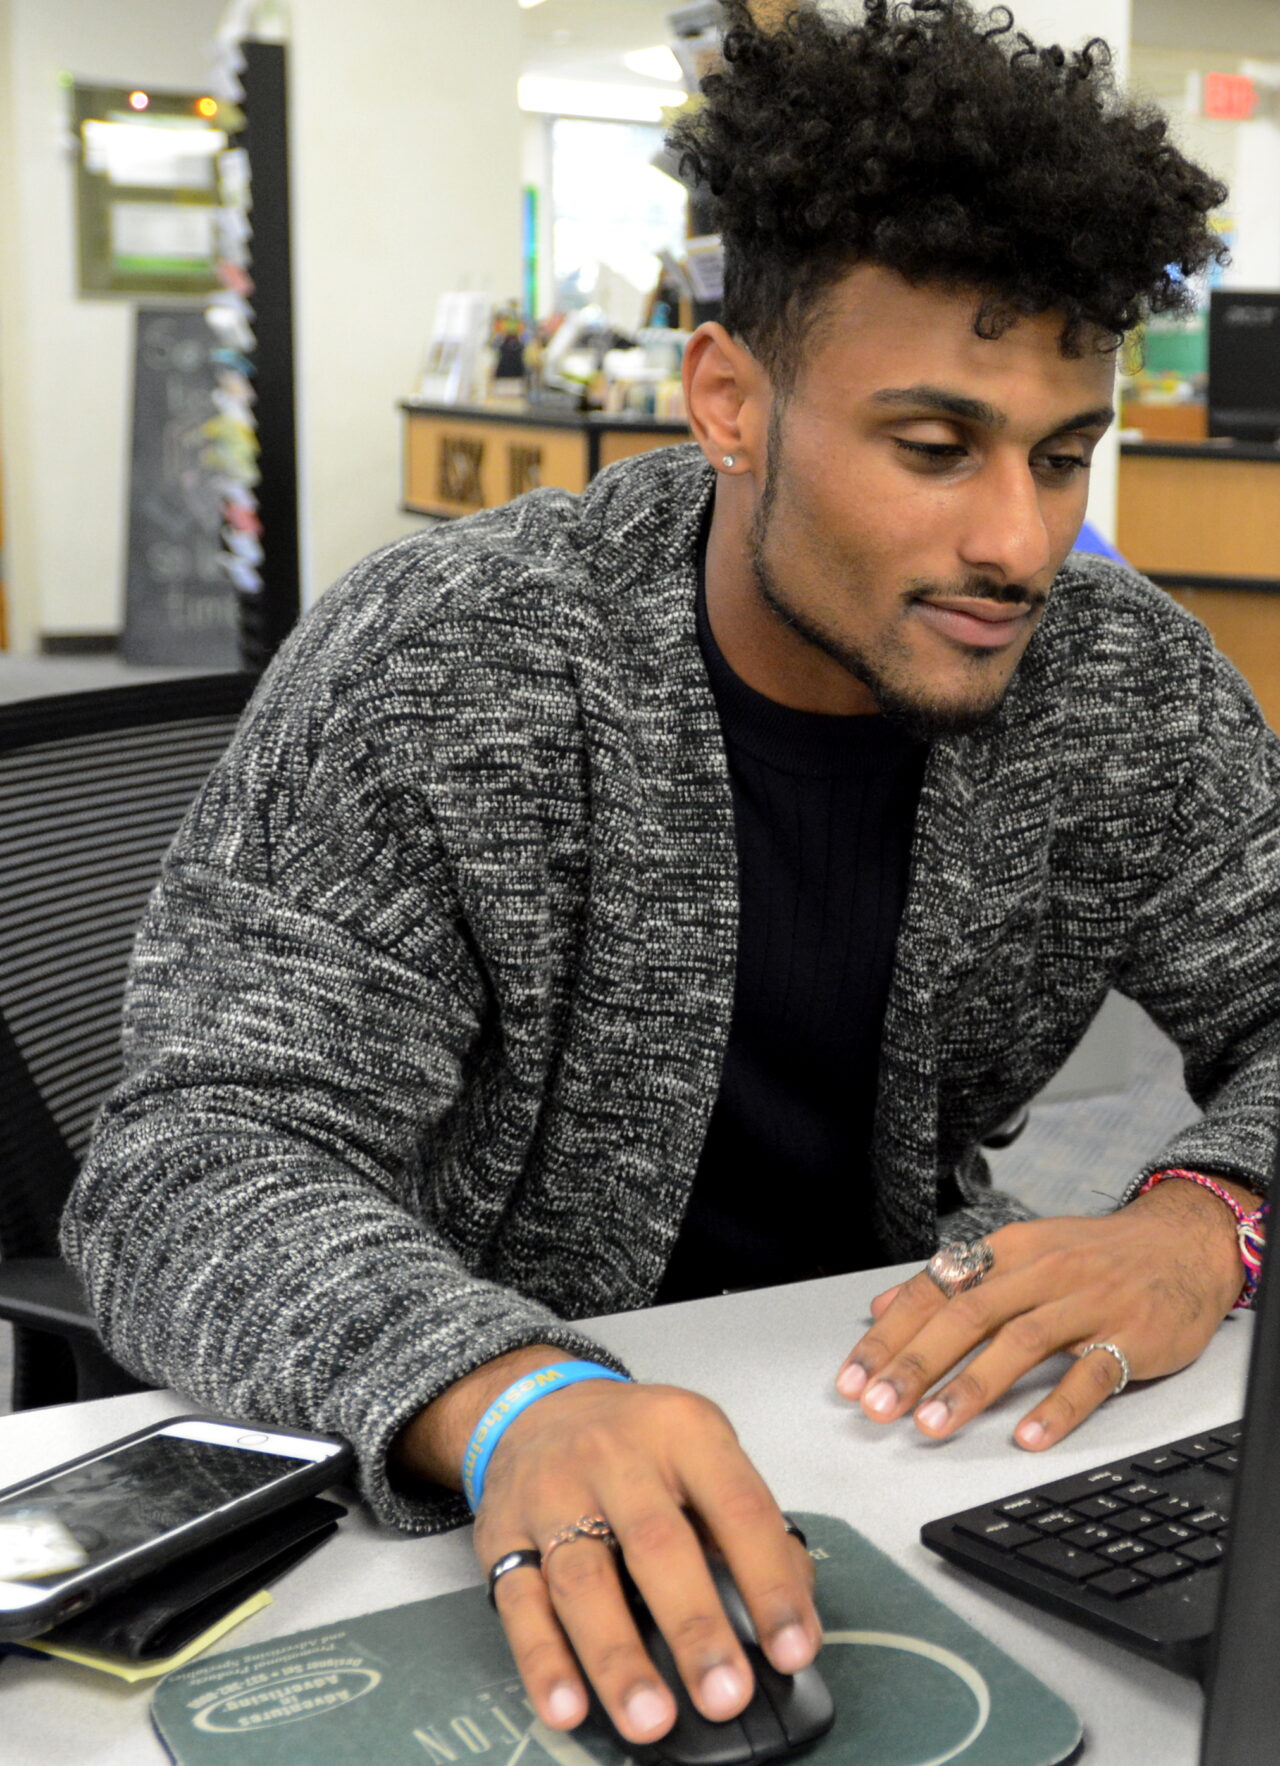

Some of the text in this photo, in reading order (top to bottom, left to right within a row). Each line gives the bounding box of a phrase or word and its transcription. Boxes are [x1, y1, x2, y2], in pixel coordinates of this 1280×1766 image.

[321, 1631, 347, 1645] and
[243, 1639, 318, 1664] Advertising
[225, 1674, 340, 1712] Advertising
[280, 1693, 299, 1706] in
[237, 1689, 350, 1727] Adventures
